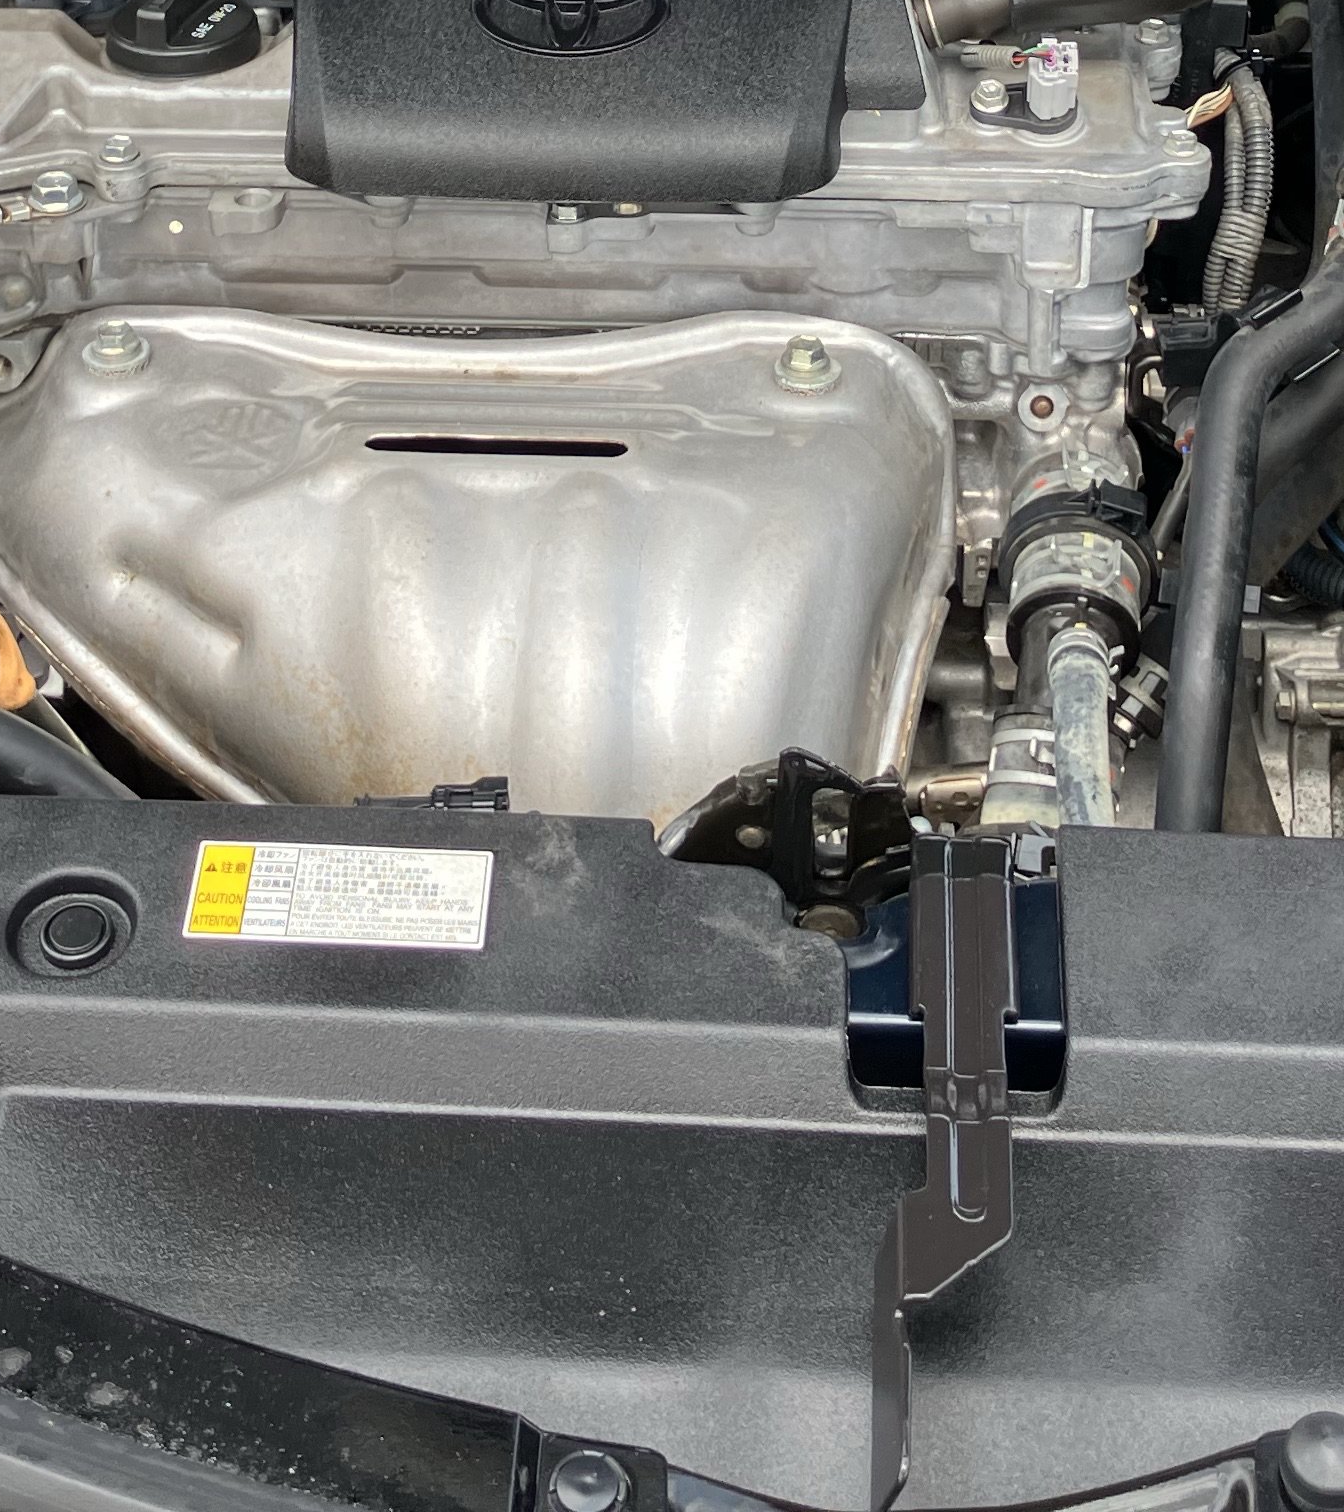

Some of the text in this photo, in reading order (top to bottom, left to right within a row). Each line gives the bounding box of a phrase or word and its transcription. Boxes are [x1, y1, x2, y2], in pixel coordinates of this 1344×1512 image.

[191, 22, 214, 38] SAE
[222, 862, 247, 874] 注意
[198, 893, 243, 904] CAUTION
[248, 896, 290, 905] COOLING FANS
[319, 899, 342, 907] FROM
[193, 915, 239, 927] ATTENTION
[245, 918, 285, 927] VENTILATEURS
[356, 924, 402, 932] VENTILATEURS
